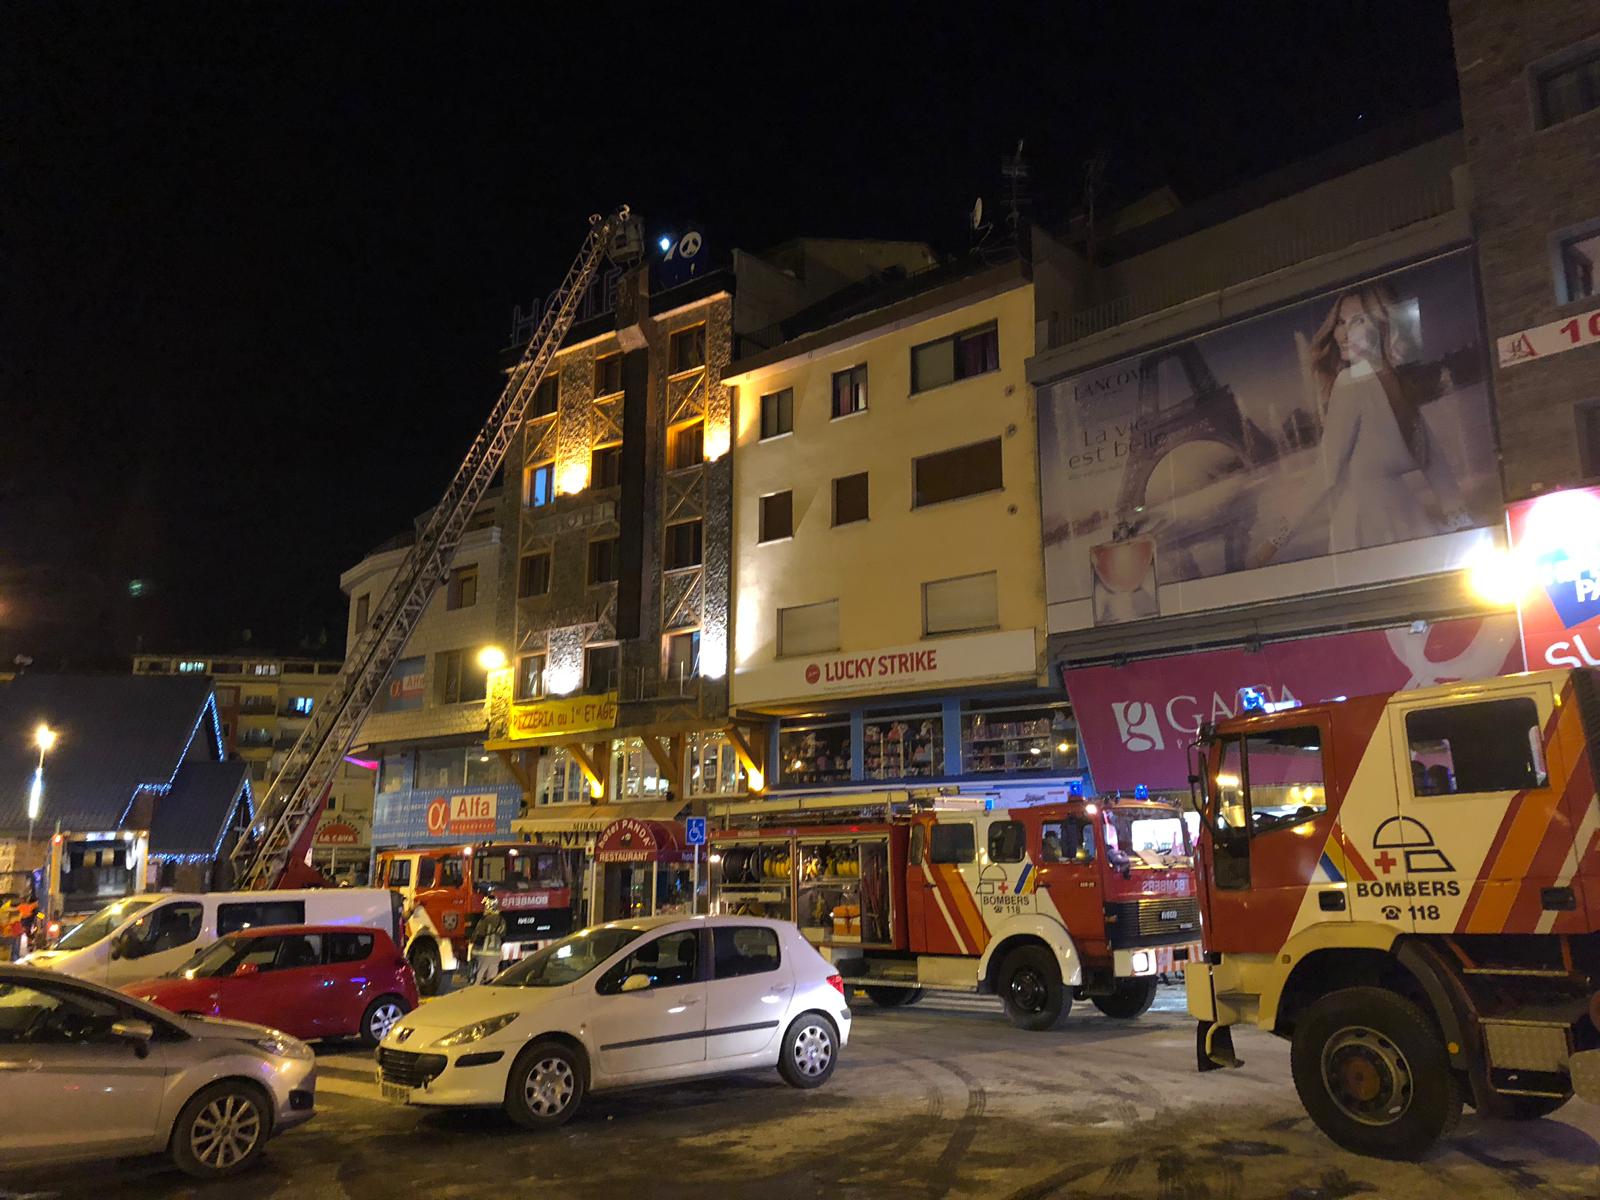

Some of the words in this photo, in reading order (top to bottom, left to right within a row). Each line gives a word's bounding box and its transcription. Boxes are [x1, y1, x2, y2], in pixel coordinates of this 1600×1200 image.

[1068, 446, 1105, 470] est
[825, 656, 876, 683] LUCKY
[877, 649, 938, 676] STRIKE
[513, 710, 555, 730] PIZZERIA
[456, 796, 491, 818] Alfa
[621, 819, 651, 846] PANDA
[599, 851, 649, 863] RESTAURANT
[1356, 880, 1461, 898] BOMBERS
[983, 894, 1030, 906] BOMBERS
[1408, 904, 1441, 921] 118
